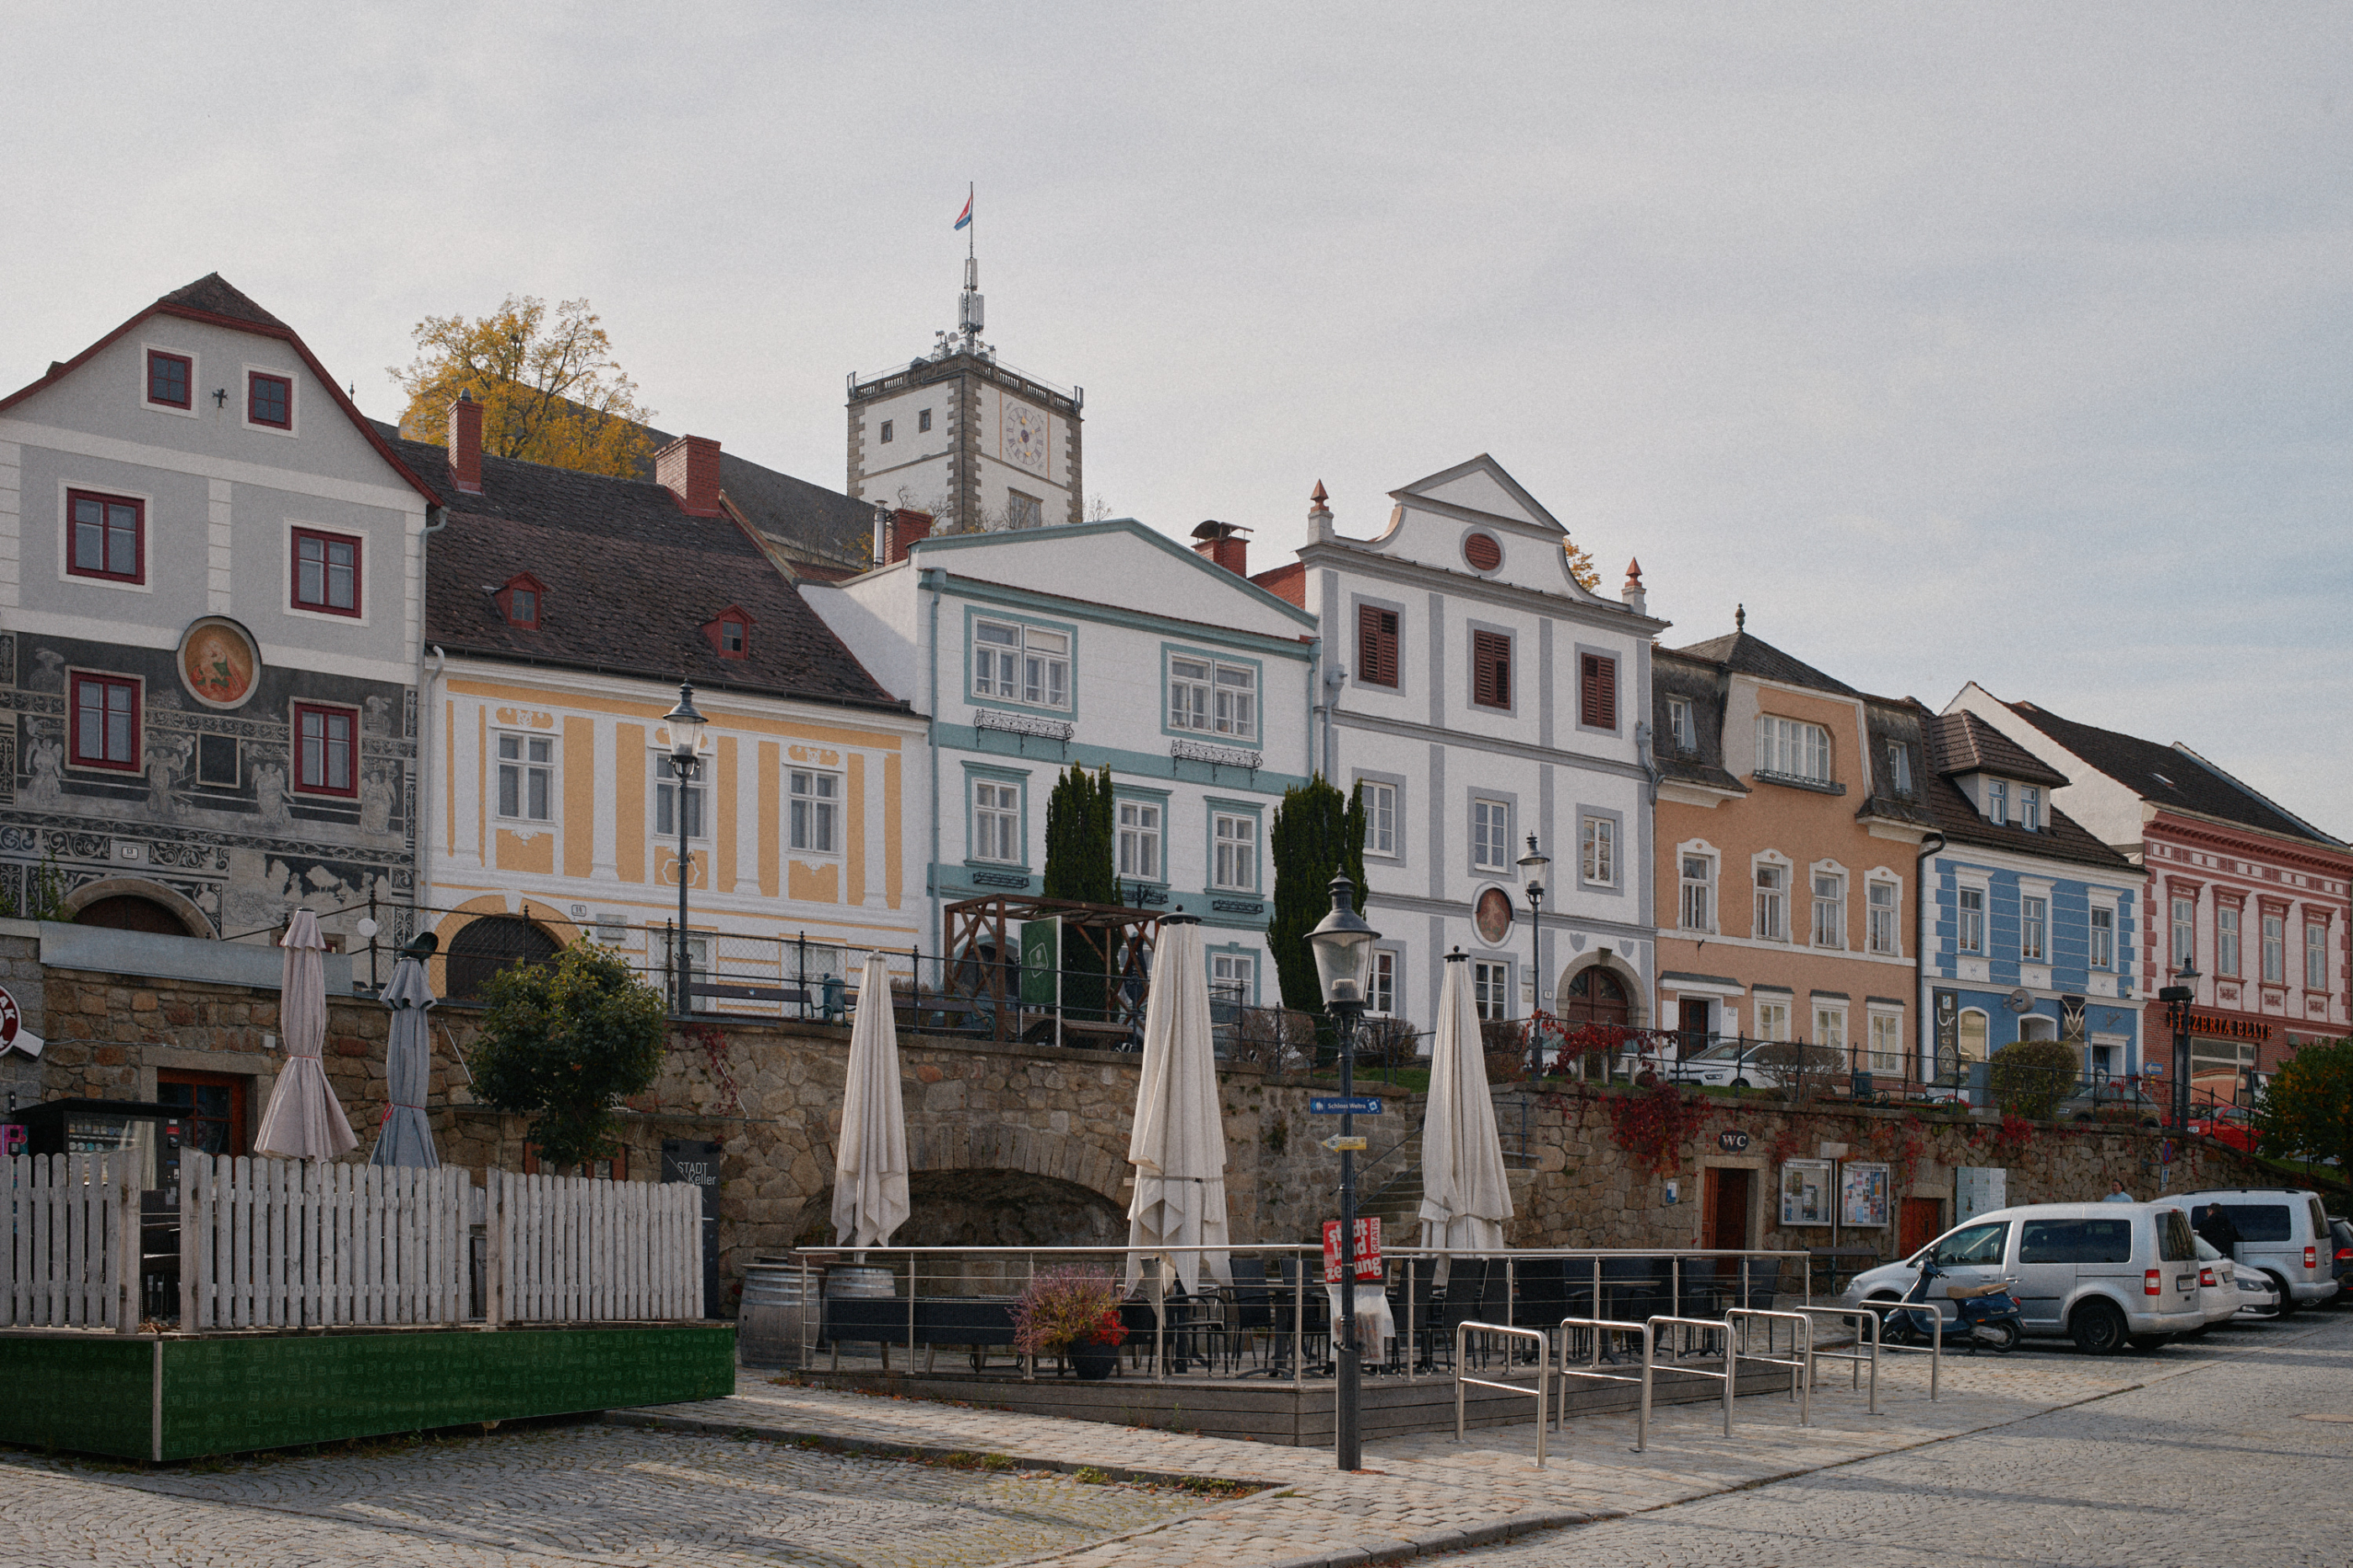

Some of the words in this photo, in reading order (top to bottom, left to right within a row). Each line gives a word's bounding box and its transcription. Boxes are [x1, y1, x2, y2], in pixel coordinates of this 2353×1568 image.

[2169, 1011, 2232, 1034] IZERIA
[2237, 1020, 2273, 1039] ELITE
[1722, 1134, 1746, 1147] WC
[677, 1162, 708, 1175] STADT
[1329, 1219, 1368, 1244] stdt
[1333, 1235, 1367, 1260] ld
[1324, 1256, 1382, 1281] zeung
